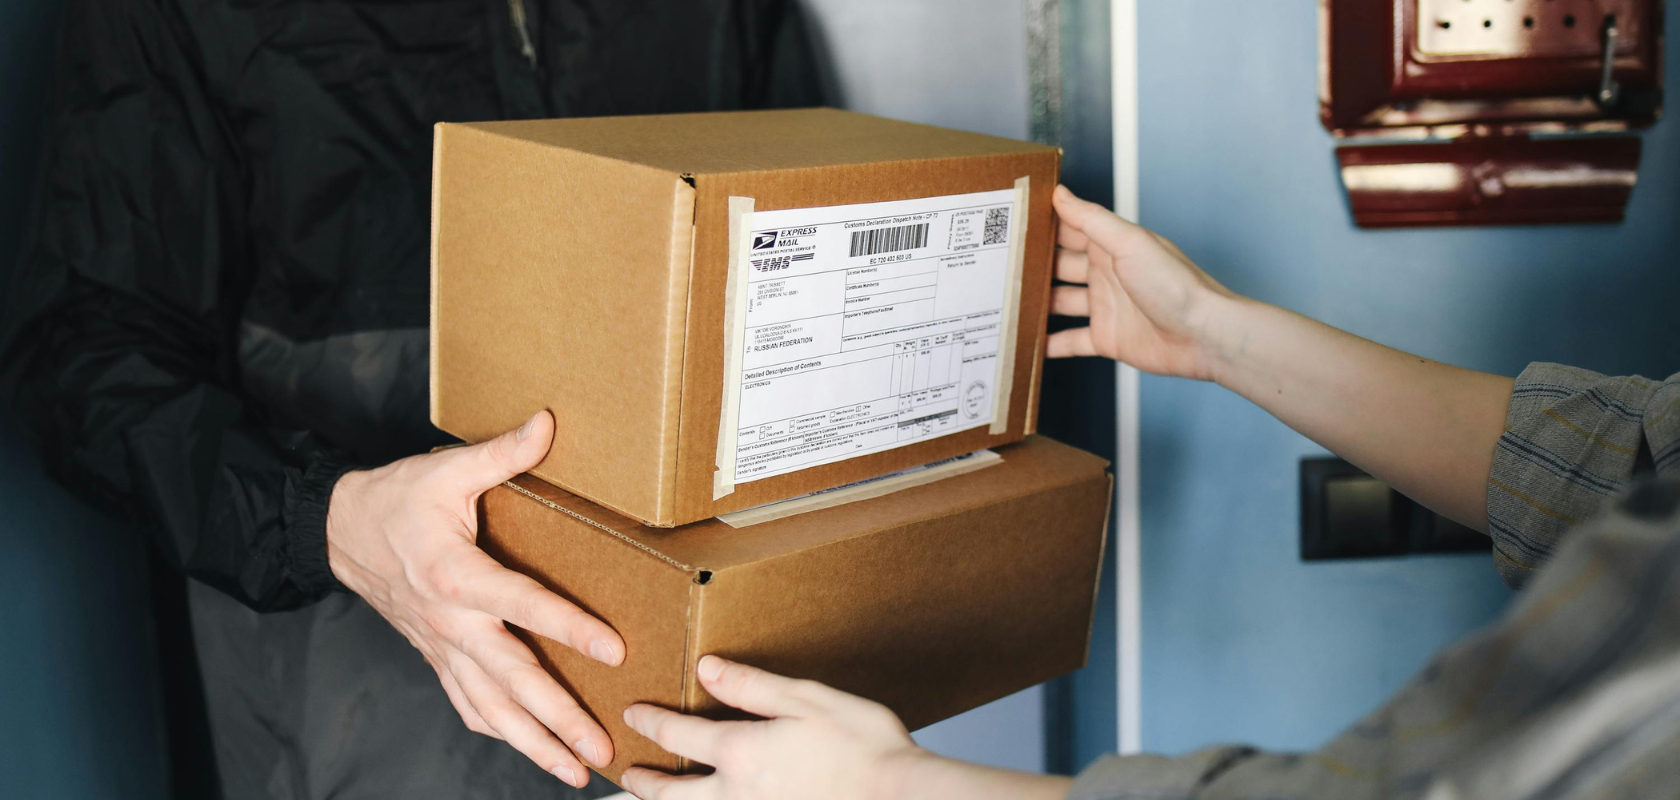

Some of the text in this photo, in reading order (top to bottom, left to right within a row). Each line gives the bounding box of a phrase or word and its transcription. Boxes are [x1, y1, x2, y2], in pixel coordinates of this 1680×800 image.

[781, 227, 817, 237] EXPRESS
[778, 238, 799, 247] MAIL
[754, 336, 813, 352] RUSSIAN FEDERATION
[745, 371, 764, 380] Detailed
[766, 366, 793, 375] Description
[800, 361, 821, 369] Contents
